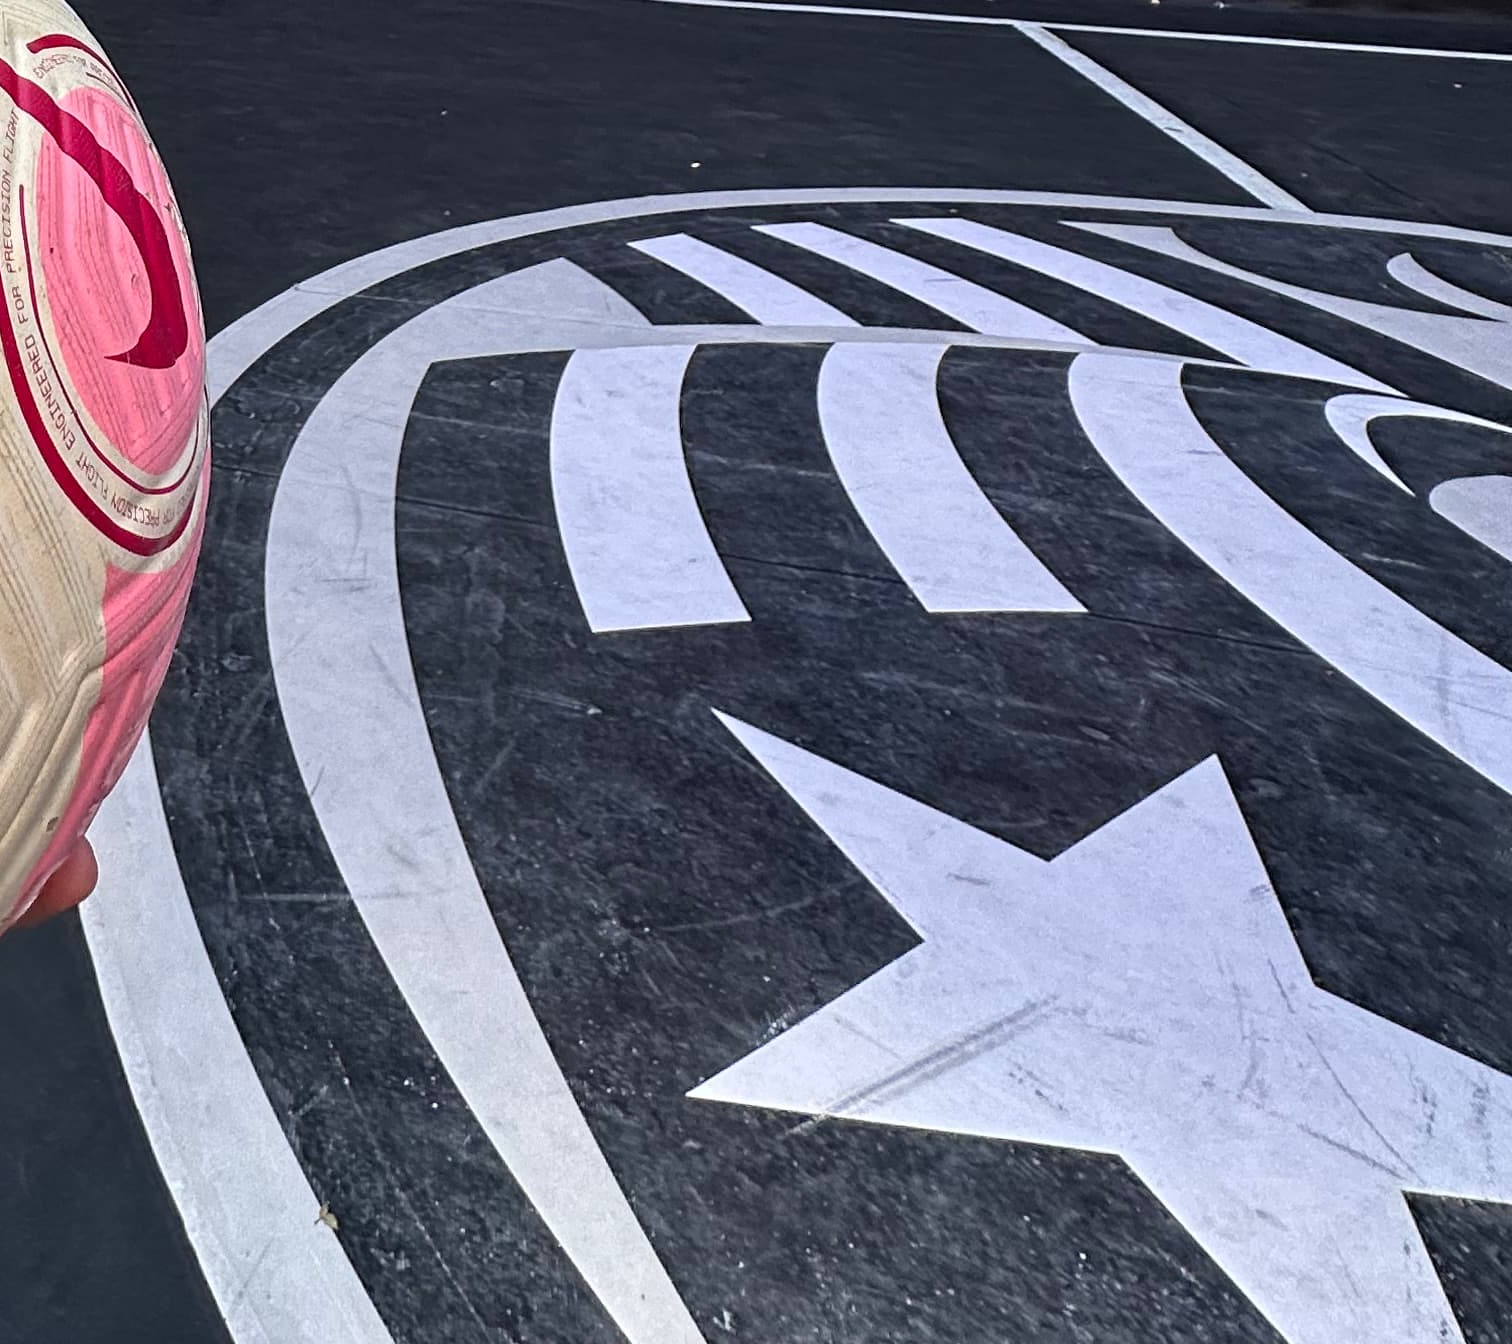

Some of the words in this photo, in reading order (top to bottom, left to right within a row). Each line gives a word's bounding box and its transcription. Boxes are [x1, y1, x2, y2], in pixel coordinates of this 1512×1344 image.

[2, 106, 20, 165] FLIGHT
[0, 169, 17, 274] PRECISION
[11, 285, 30, 325] FOR
[23, 333, 77, 452] ENGINEERED
